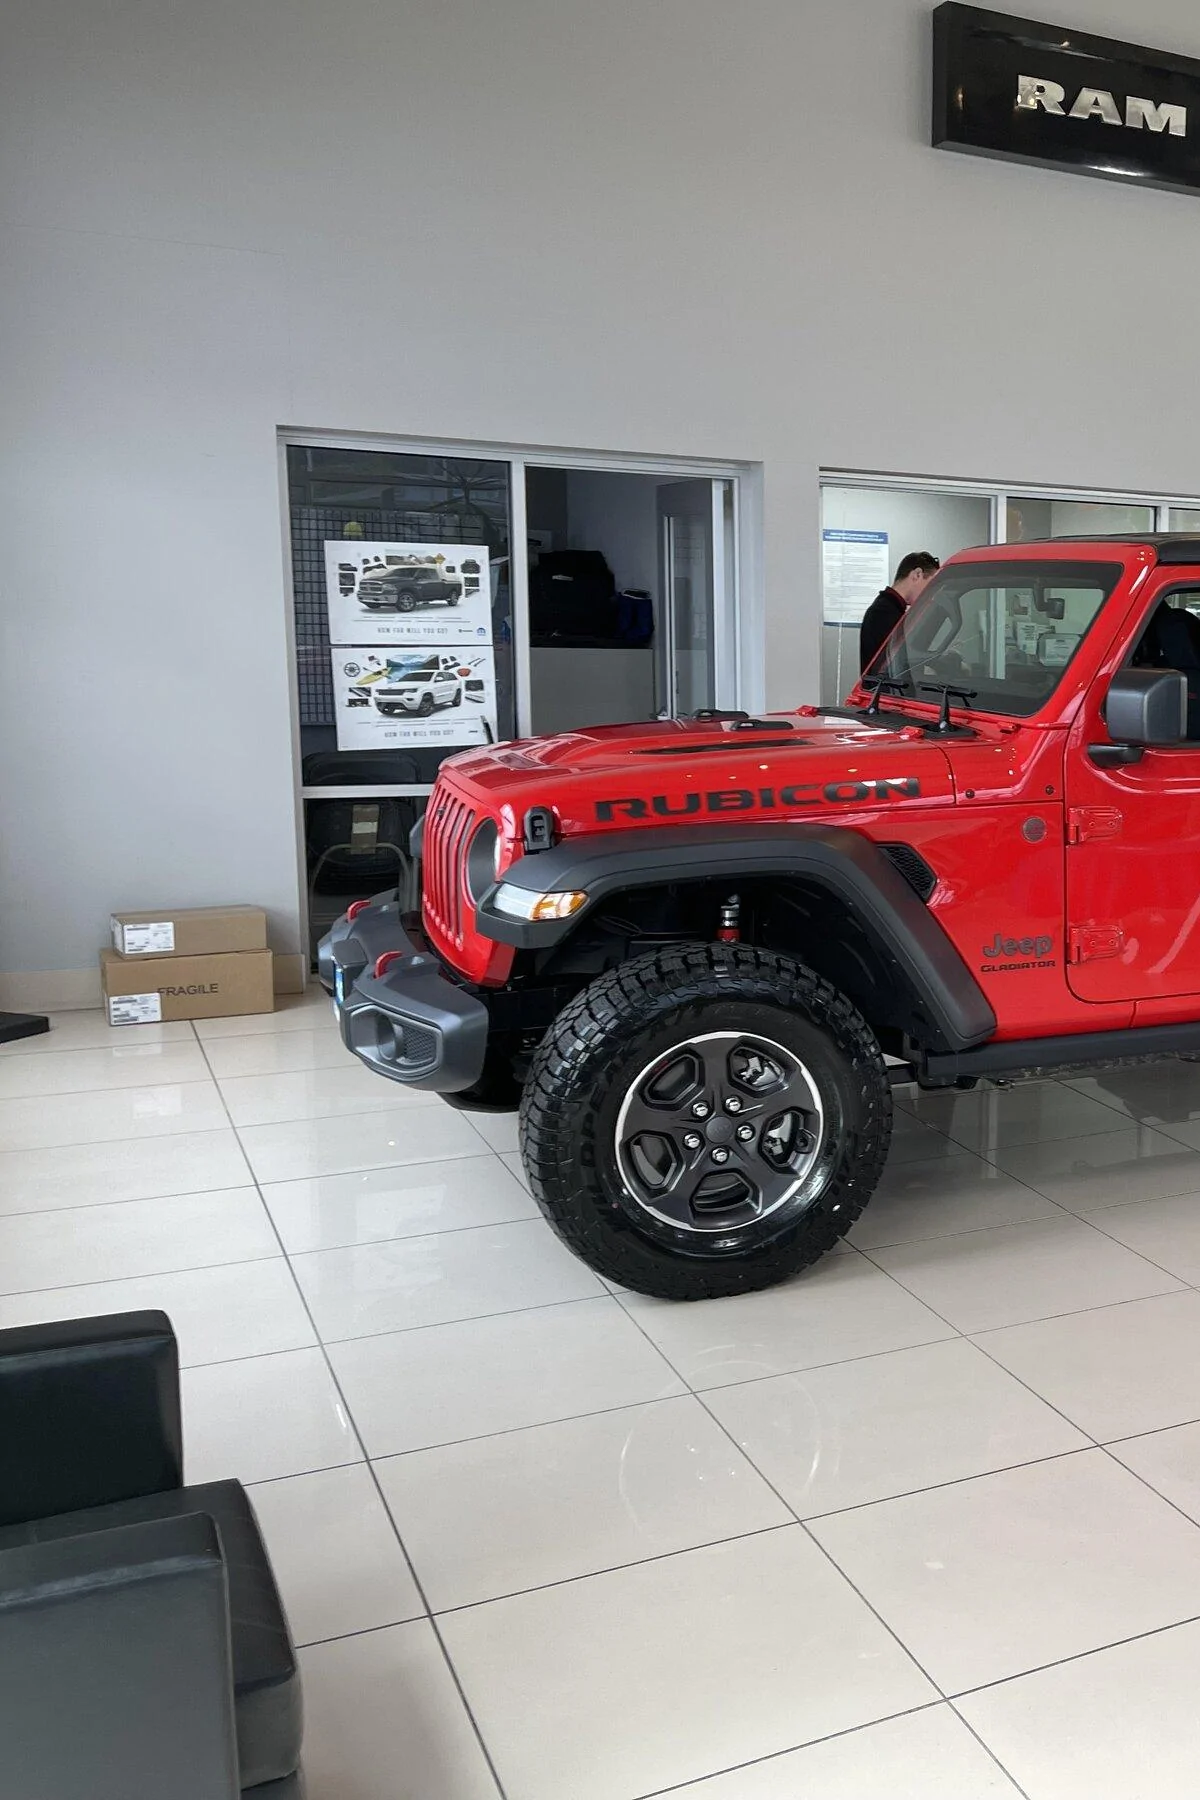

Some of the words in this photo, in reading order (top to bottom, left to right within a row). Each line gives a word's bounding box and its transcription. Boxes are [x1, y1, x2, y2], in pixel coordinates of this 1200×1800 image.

[1017, 74, 1187, 137] RAM
[595, 777, 921, 822] RUBICON
[983, 933, 1053, 958] Jeep
[980, 960, 1056, 972] GLADIATOR
[157, 983, 219, 996] FRAGILE
